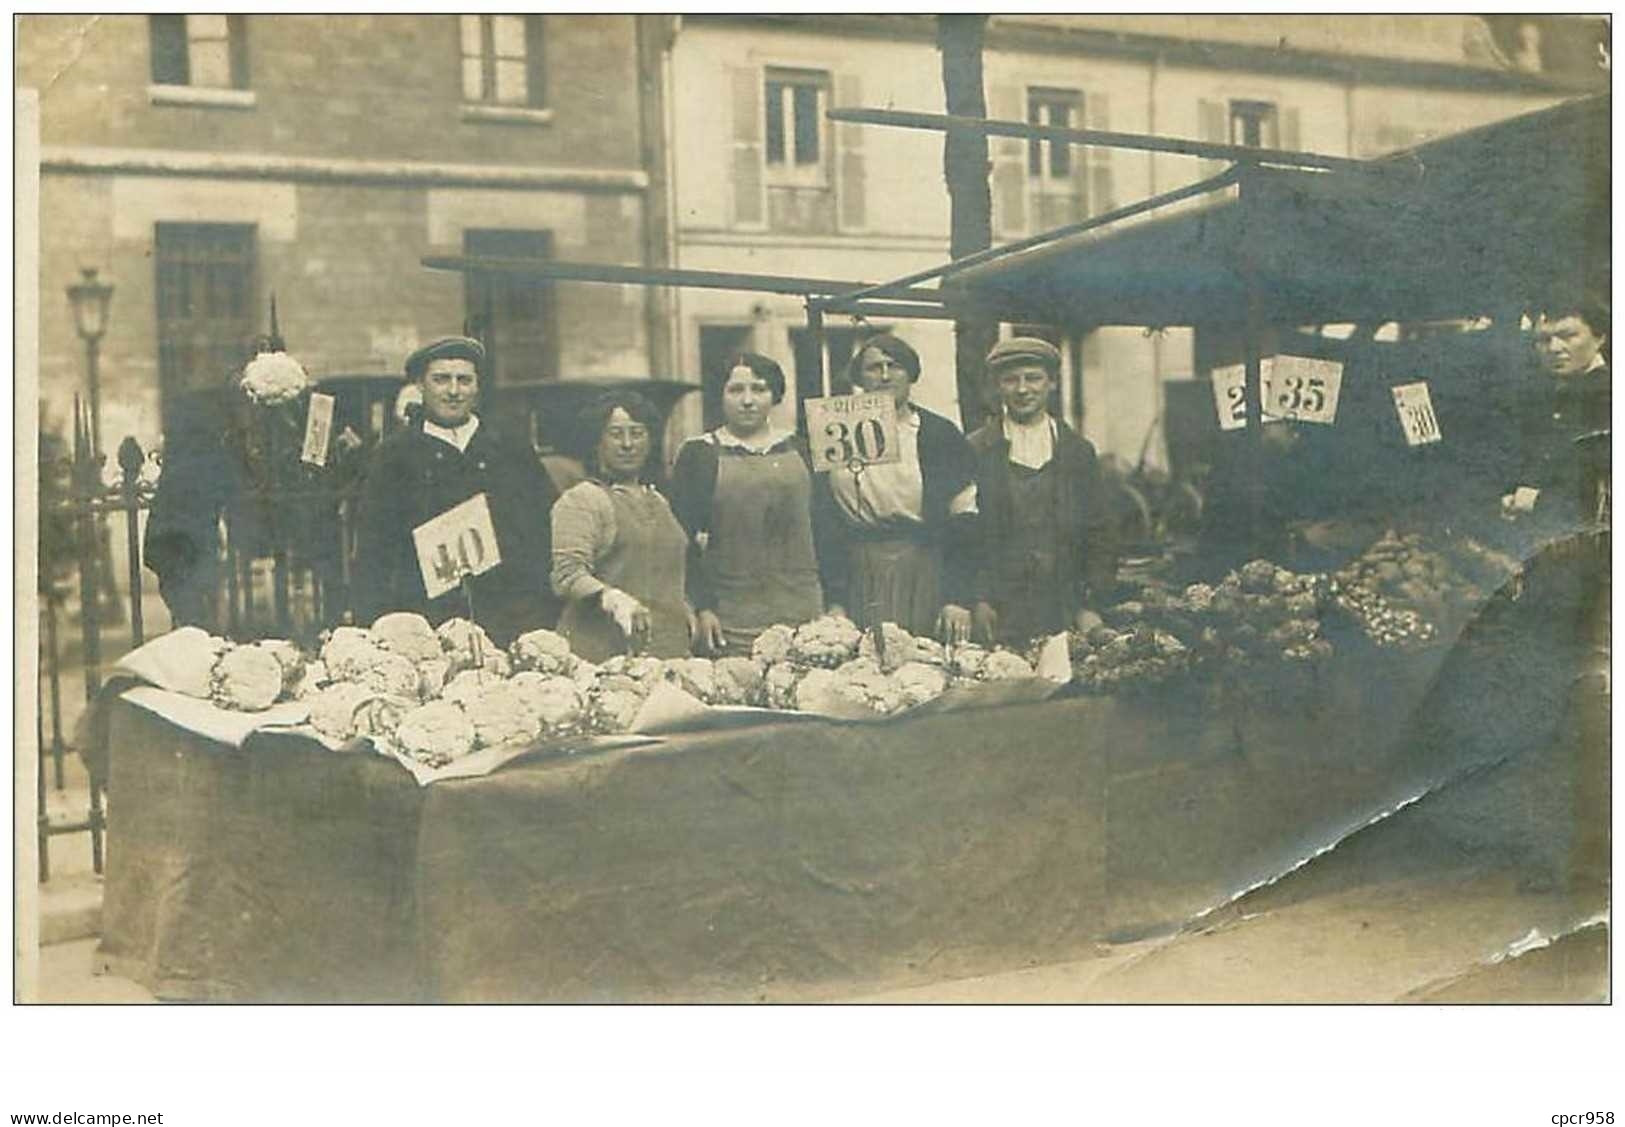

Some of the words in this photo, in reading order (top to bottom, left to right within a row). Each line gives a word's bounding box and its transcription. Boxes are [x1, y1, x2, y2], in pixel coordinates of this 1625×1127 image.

[1279, 377, 1325, 412] 35
[824, 419, 886, 463] 30
[433, 528, 485, 581] 40
